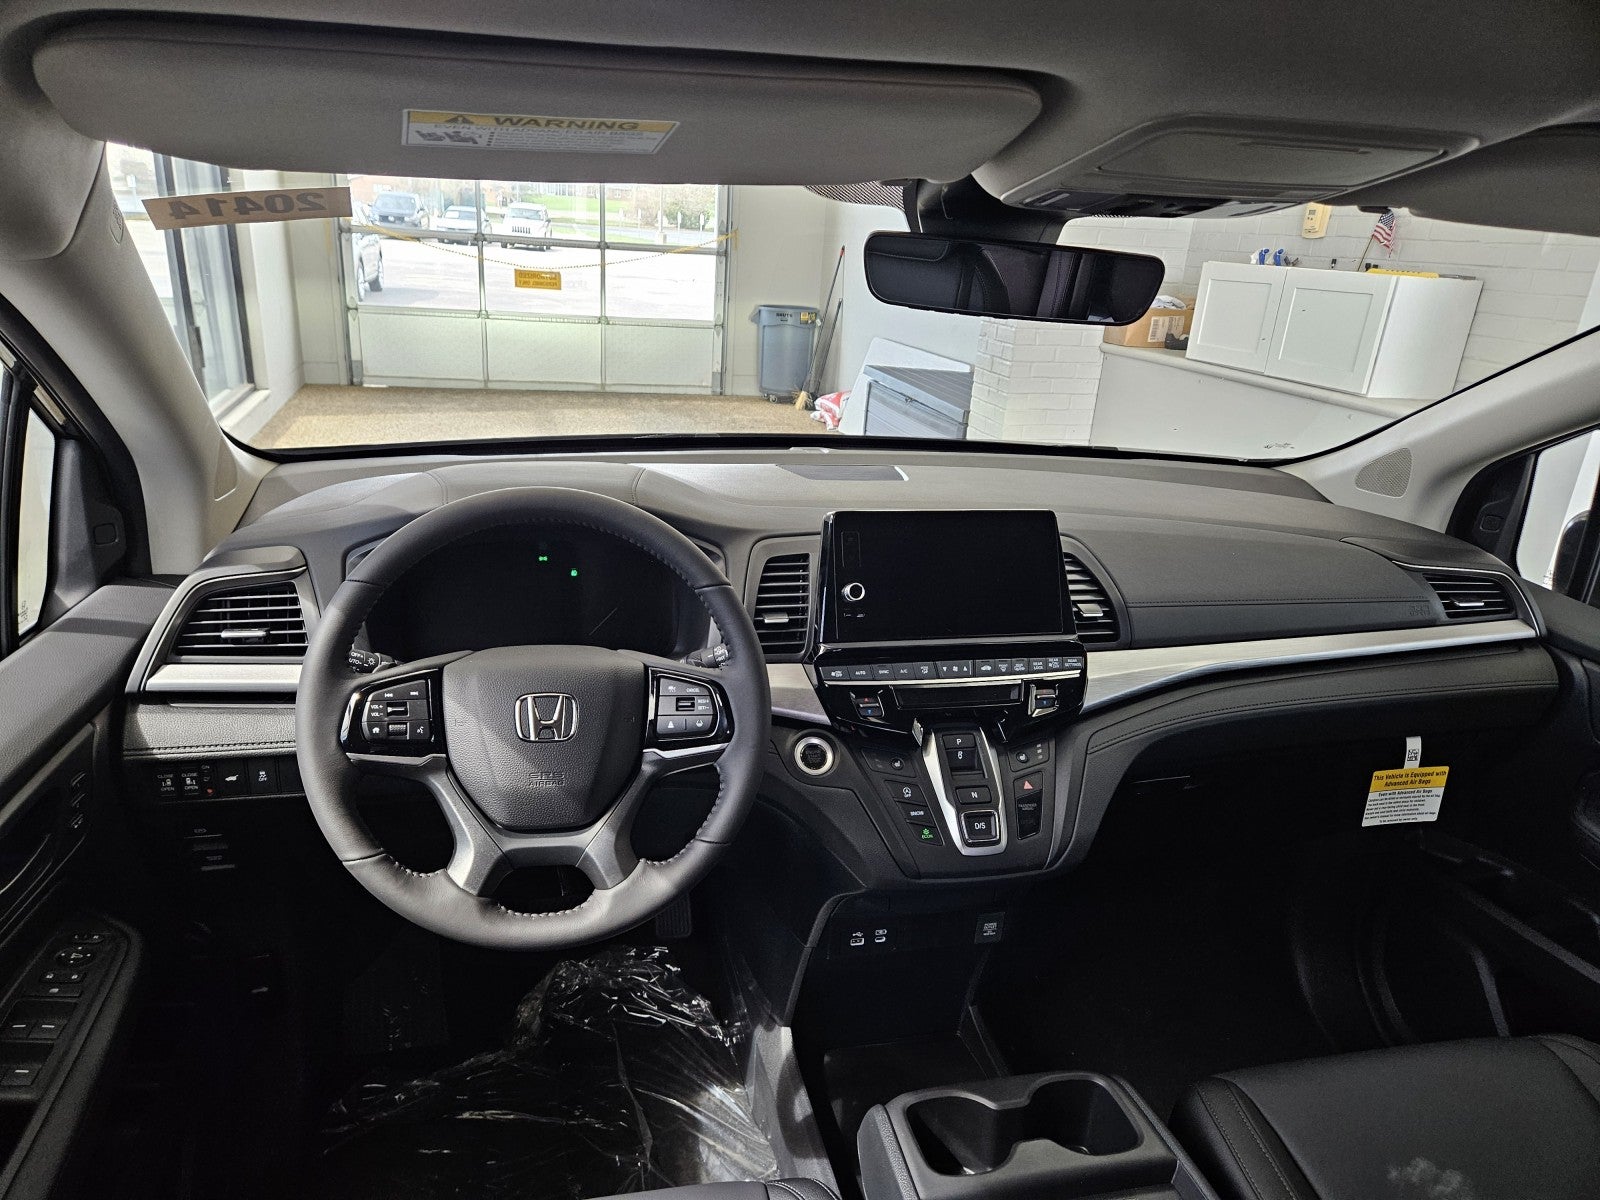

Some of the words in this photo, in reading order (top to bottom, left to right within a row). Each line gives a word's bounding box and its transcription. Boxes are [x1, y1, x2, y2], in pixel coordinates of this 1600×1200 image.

[493, 117, 639, 130] WARNING
[1385, 772, 1404, 780] Vehicle
[1410, 771, 1434, 779] Equipped
[1418, 778, 1431, 786] Bags
[974, 822, 986, 830] D/S
